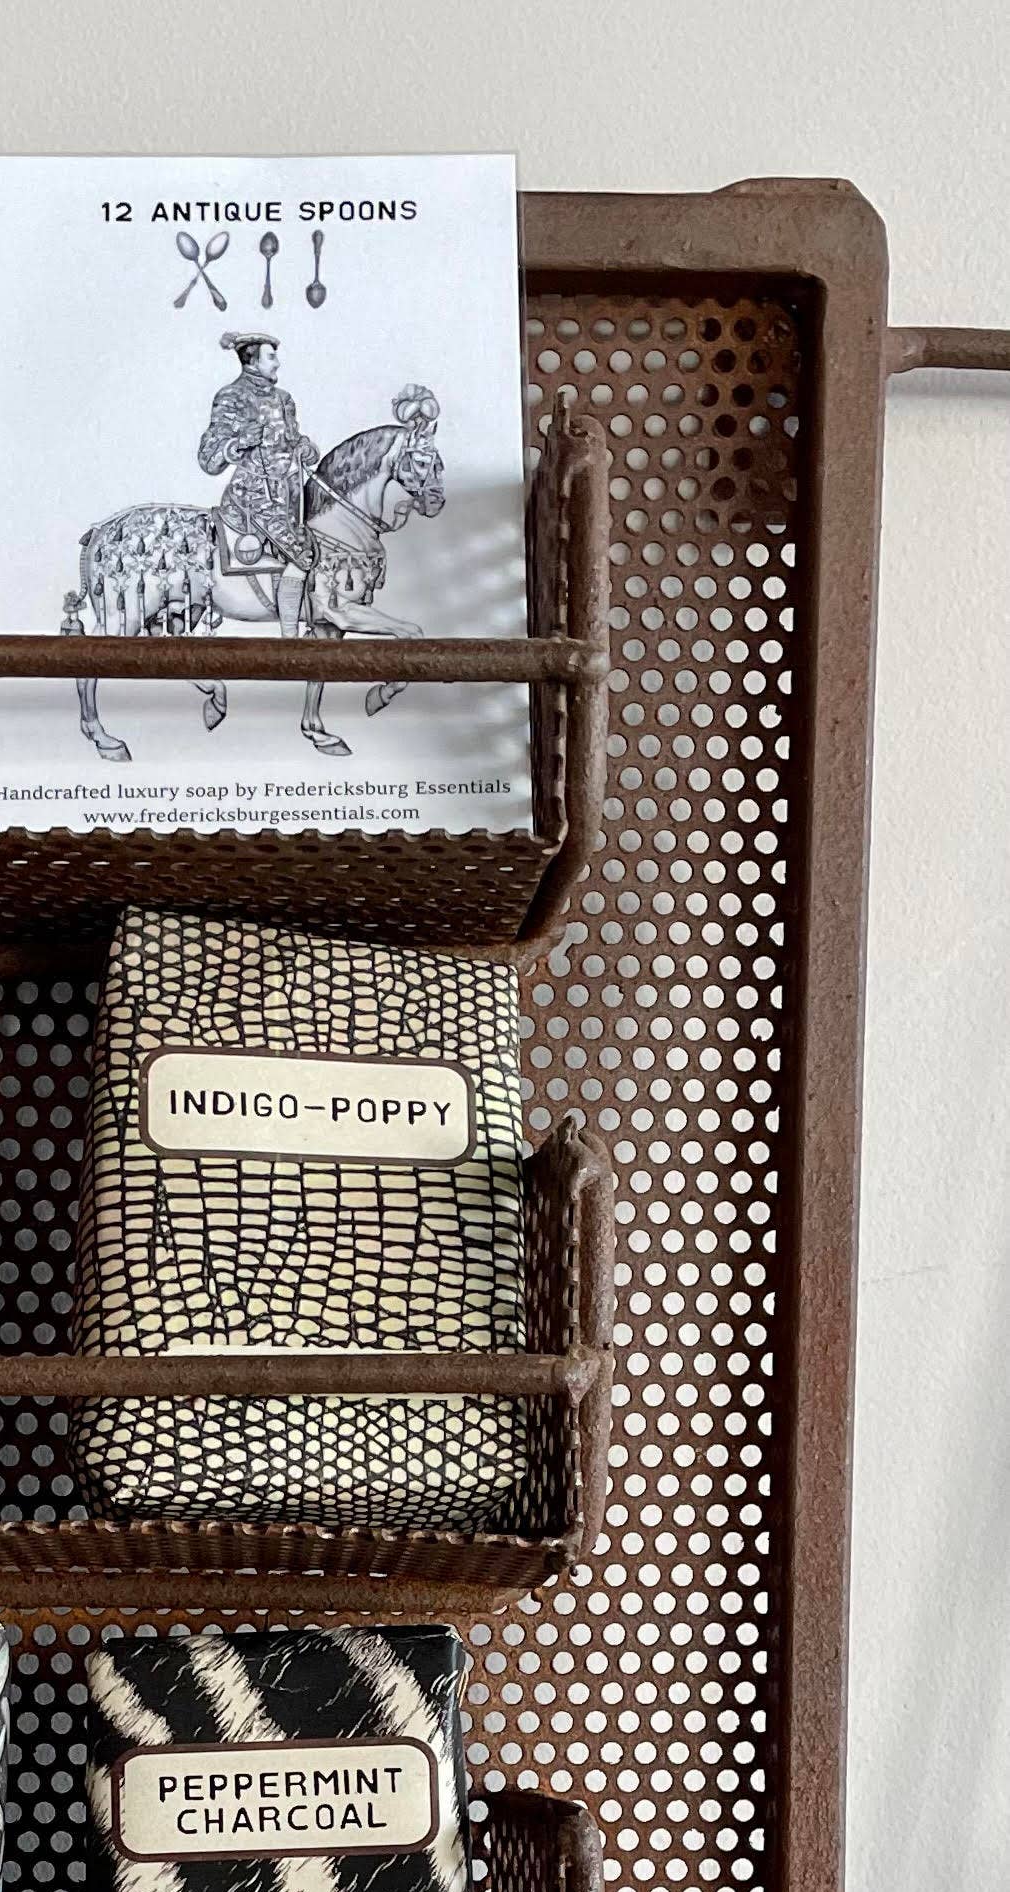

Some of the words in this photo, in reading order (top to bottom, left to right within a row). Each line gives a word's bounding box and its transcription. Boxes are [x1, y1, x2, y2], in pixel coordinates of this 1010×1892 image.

[101, 201, 133, 223] 12
[150, 201, 282, 223] ANTIQUE
[298, 200, 418, 222] SPOONS
[117, 783, 180, 801] luxury
[185, 784, 230, 801] soap
[235, 782, 258, 801] by
[263, 780, 409, 799] Fredericksburg
[415, 779, 512, 795] Essentials
[83, 805, 420, 825] www.fredericksburgessentials.com
[169, 1089, 451, 1126] INDIGO-POPPY
[158, 1767, 403, 1803] PEPPERMINT
[176, 1801, 388, 1835] CHARCOAL
